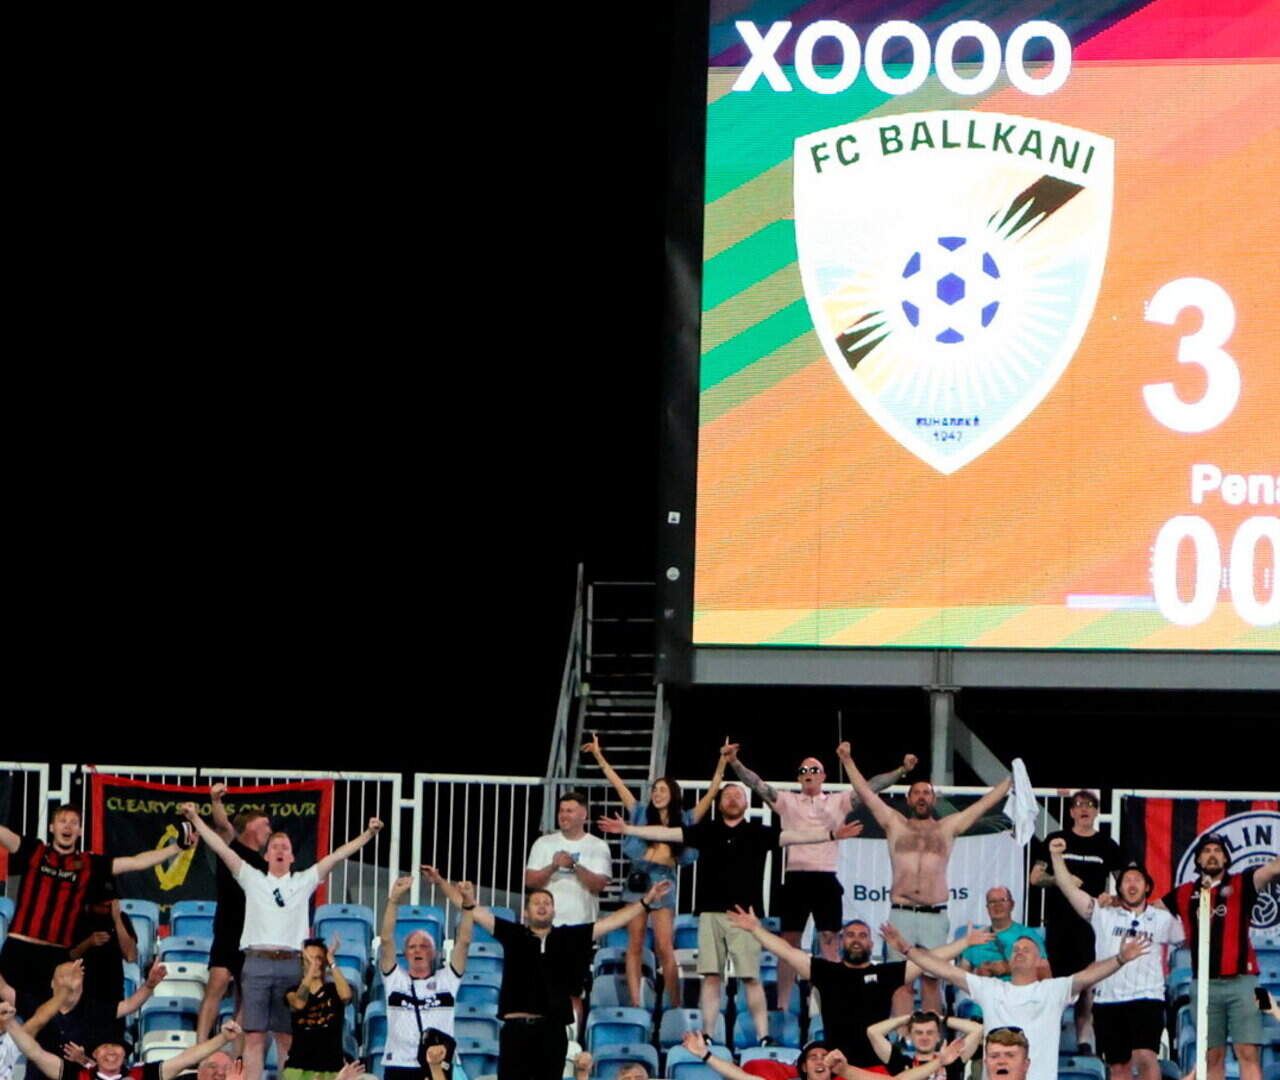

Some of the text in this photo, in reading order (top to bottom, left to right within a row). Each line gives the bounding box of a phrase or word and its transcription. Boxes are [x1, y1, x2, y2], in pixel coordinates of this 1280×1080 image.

[810, 119, 1095, 174] FC BALLKANI
[1142, 276, 1241, 433] 3
[197, 802, 235, 816] BOS
[272, 801, 317, 816] TOUR
